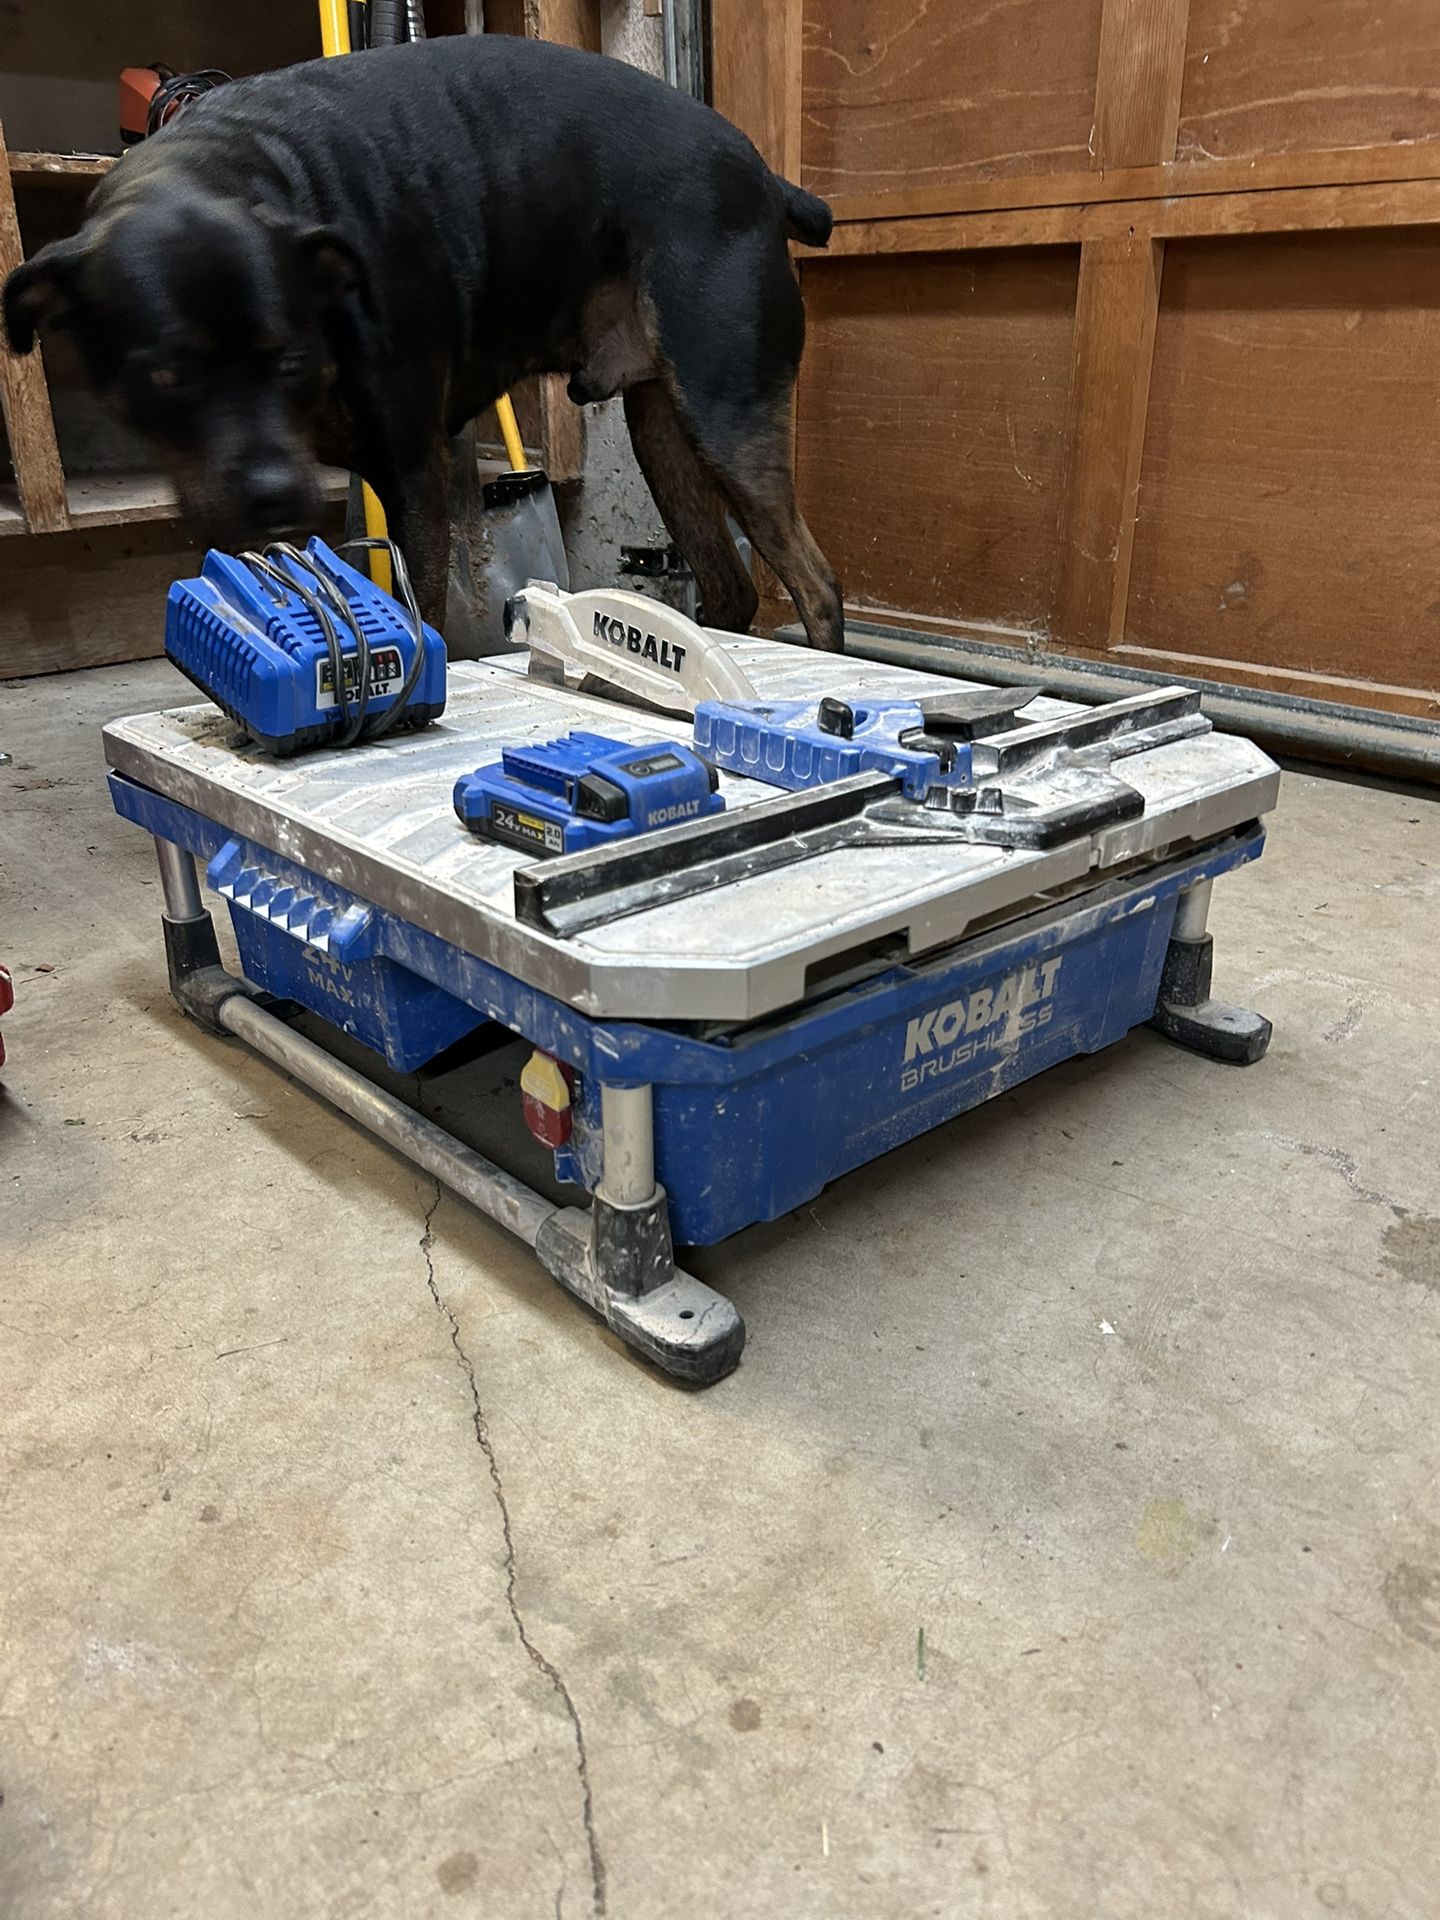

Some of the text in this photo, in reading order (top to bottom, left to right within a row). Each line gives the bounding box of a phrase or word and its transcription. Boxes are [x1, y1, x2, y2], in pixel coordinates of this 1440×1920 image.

[593, 610, 687, 673] KOBALT
[546, 826, 561, 839] 2.0
[648, 799, 700, 826] KOBALT
[521, 827, 544, 841] MAX
[307, 966, 356, 1008] MAX
[904, 956, 1062, 1063] KOBALT
[900, 1004, 1054, 1093] BRUSHLSS
